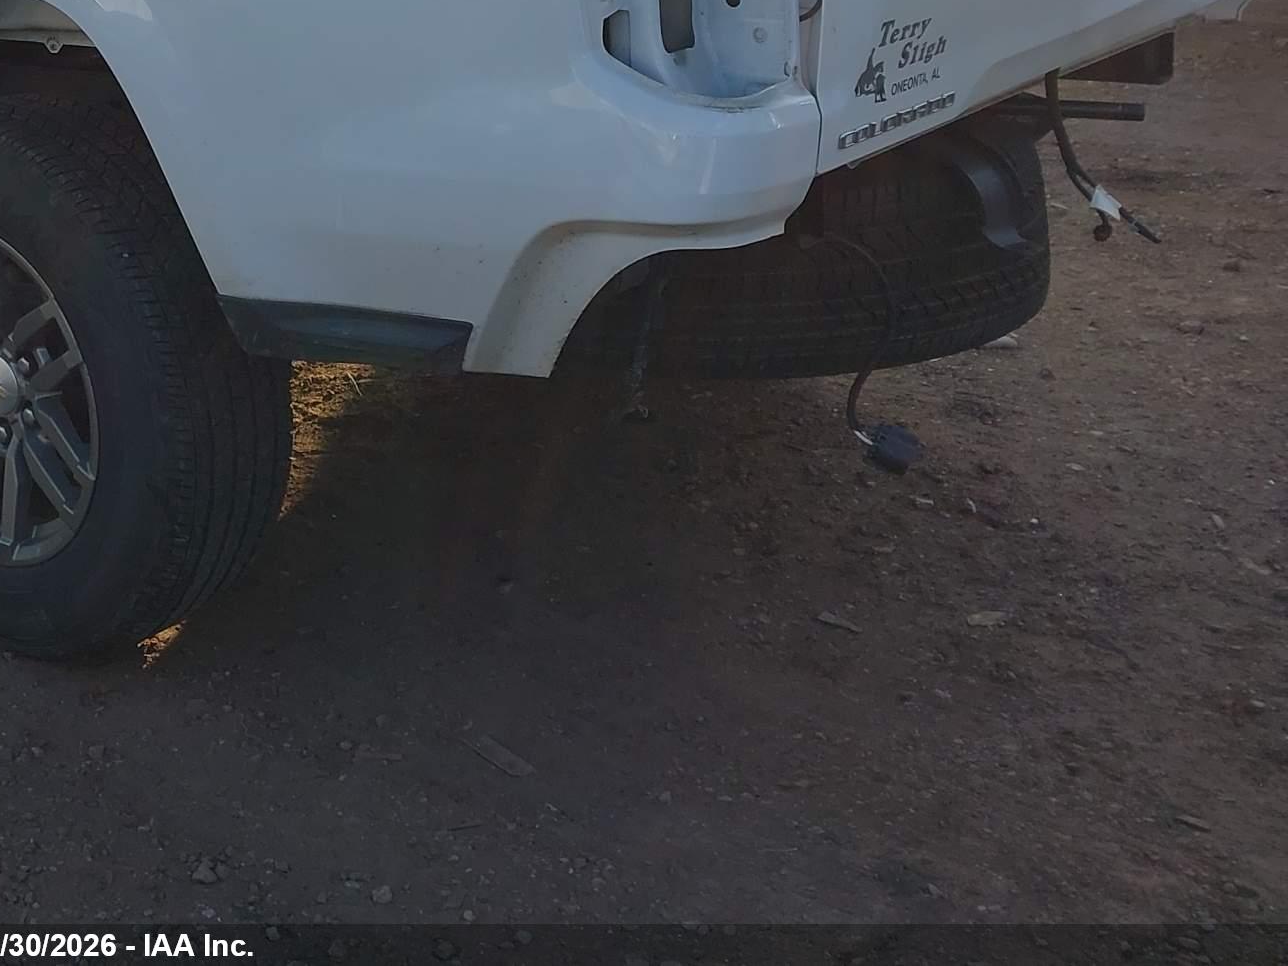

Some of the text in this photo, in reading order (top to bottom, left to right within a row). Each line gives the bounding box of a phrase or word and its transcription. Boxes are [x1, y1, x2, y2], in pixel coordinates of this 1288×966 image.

[878, 18, 932, 48] Terry
[898, 35, 947, 69] Sligh
[838, 90, 956, 150] COLORADO
